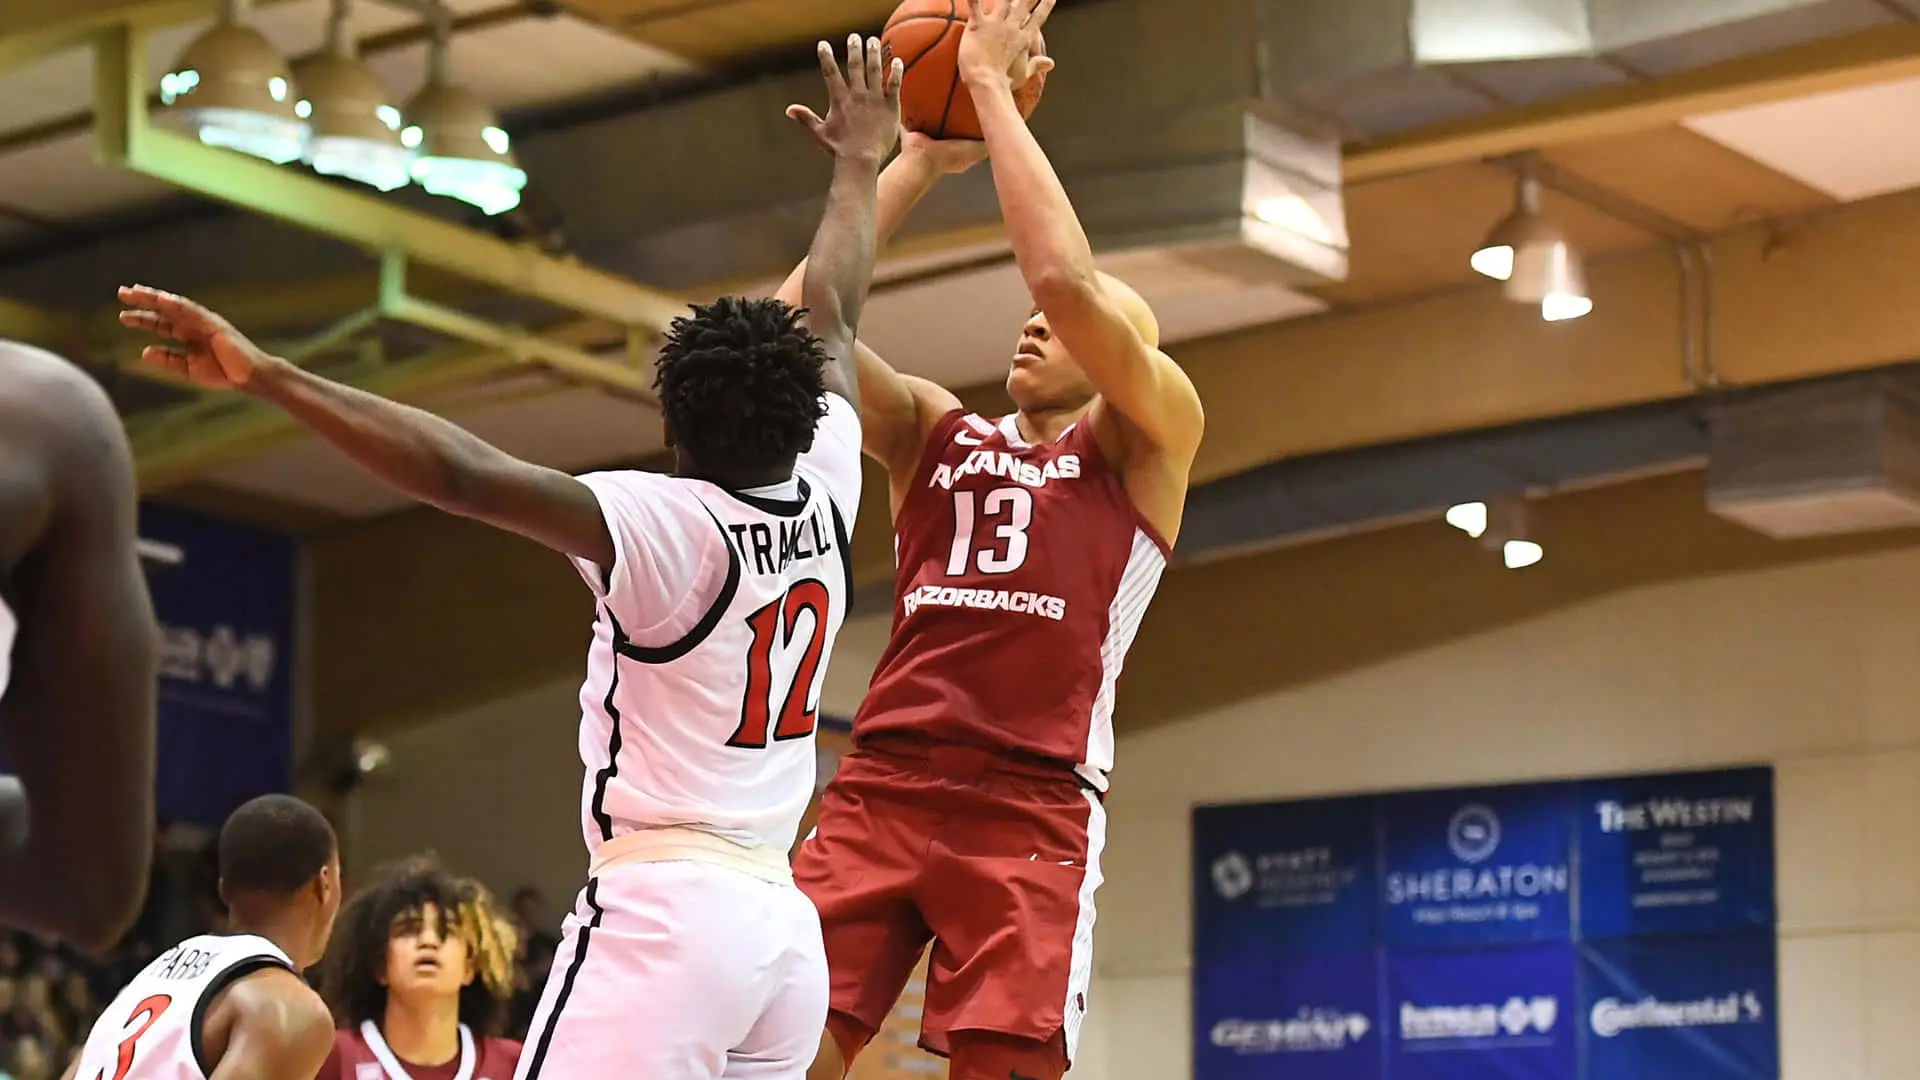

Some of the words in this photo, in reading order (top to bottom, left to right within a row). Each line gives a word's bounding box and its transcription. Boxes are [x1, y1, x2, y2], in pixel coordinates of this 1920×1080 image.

[946, 486, 1033, 576] 13
[724, 577, 830, 749] 12
[1651, 797, 1753, 827] WESTIN
[1386, 865, 1567, 904] SHERATON
[94, 993, 173, 1080] 3
